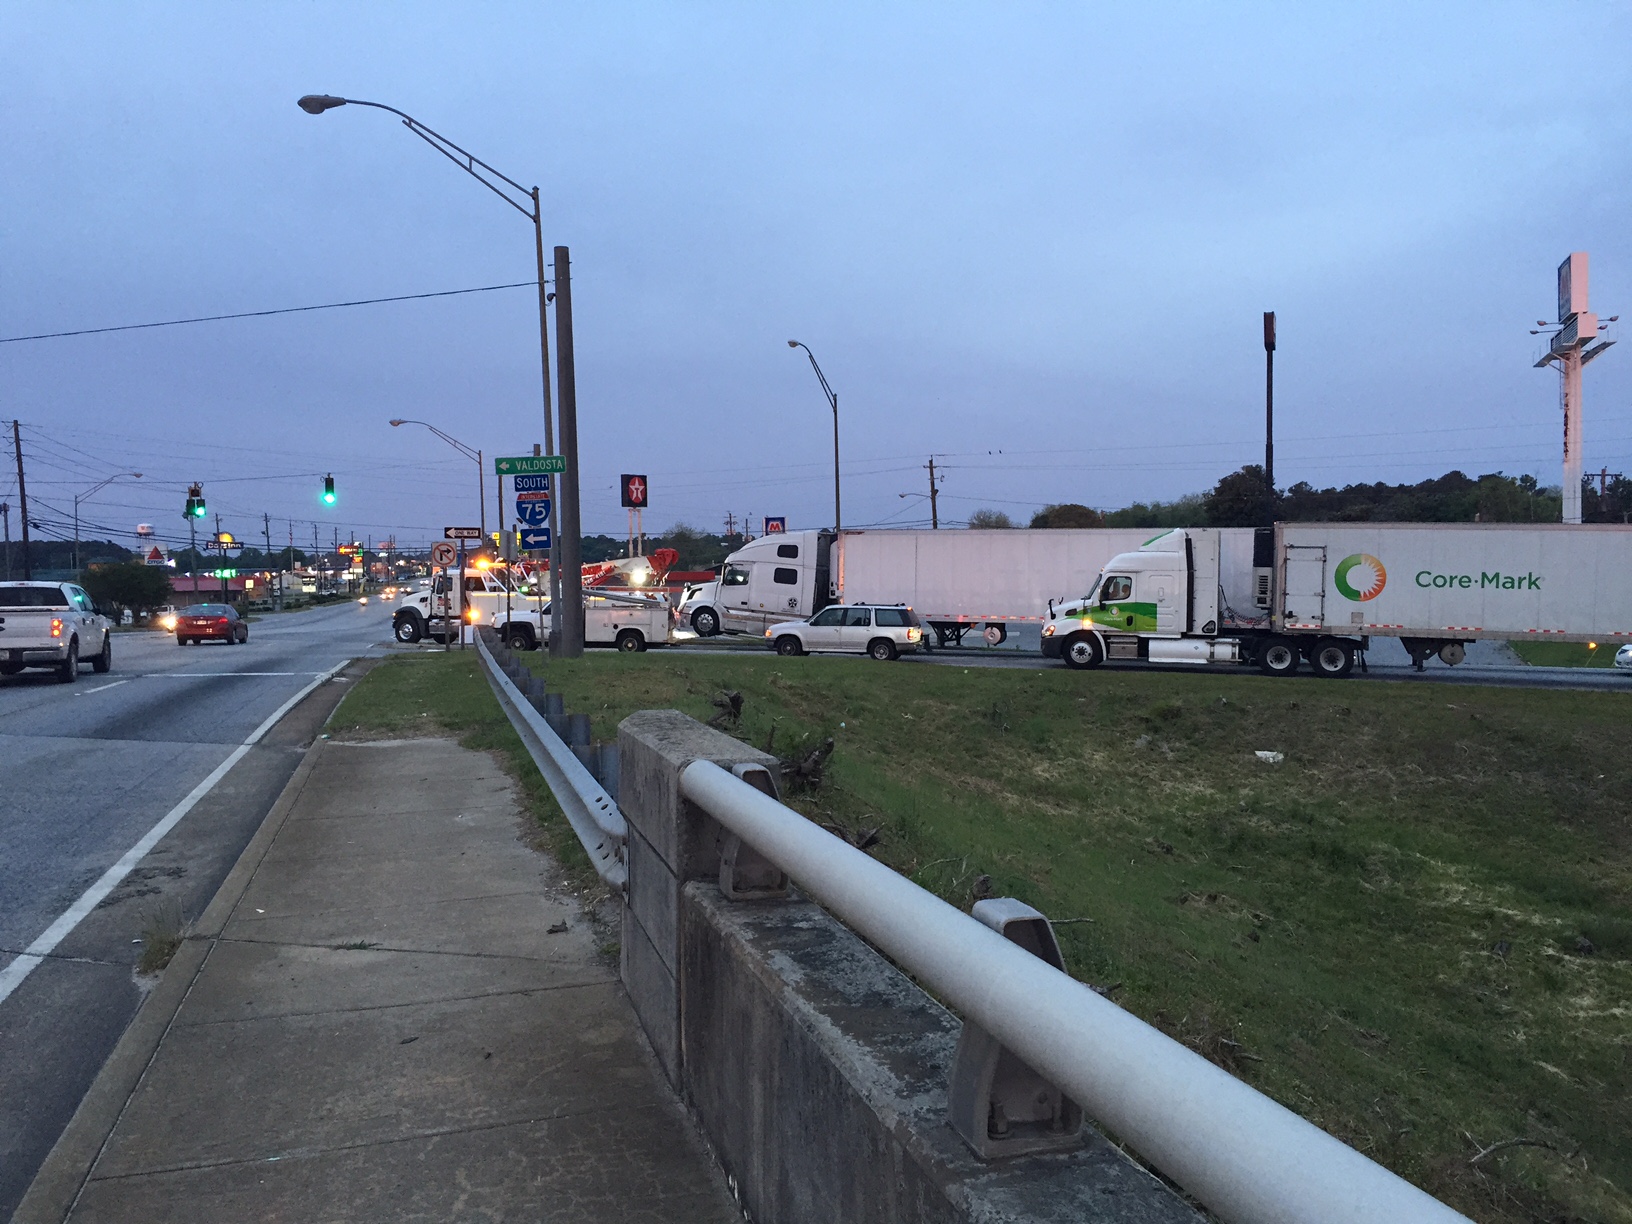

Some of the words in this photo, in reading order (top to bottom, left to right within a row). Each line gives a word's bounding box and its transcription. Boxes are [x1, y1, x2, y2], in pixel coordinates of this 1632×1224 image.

[515, 459, 563, 471] VALDOSTA
[516, 477, 548, 489] SOUTH
[521, 503, 546, 520] 75
